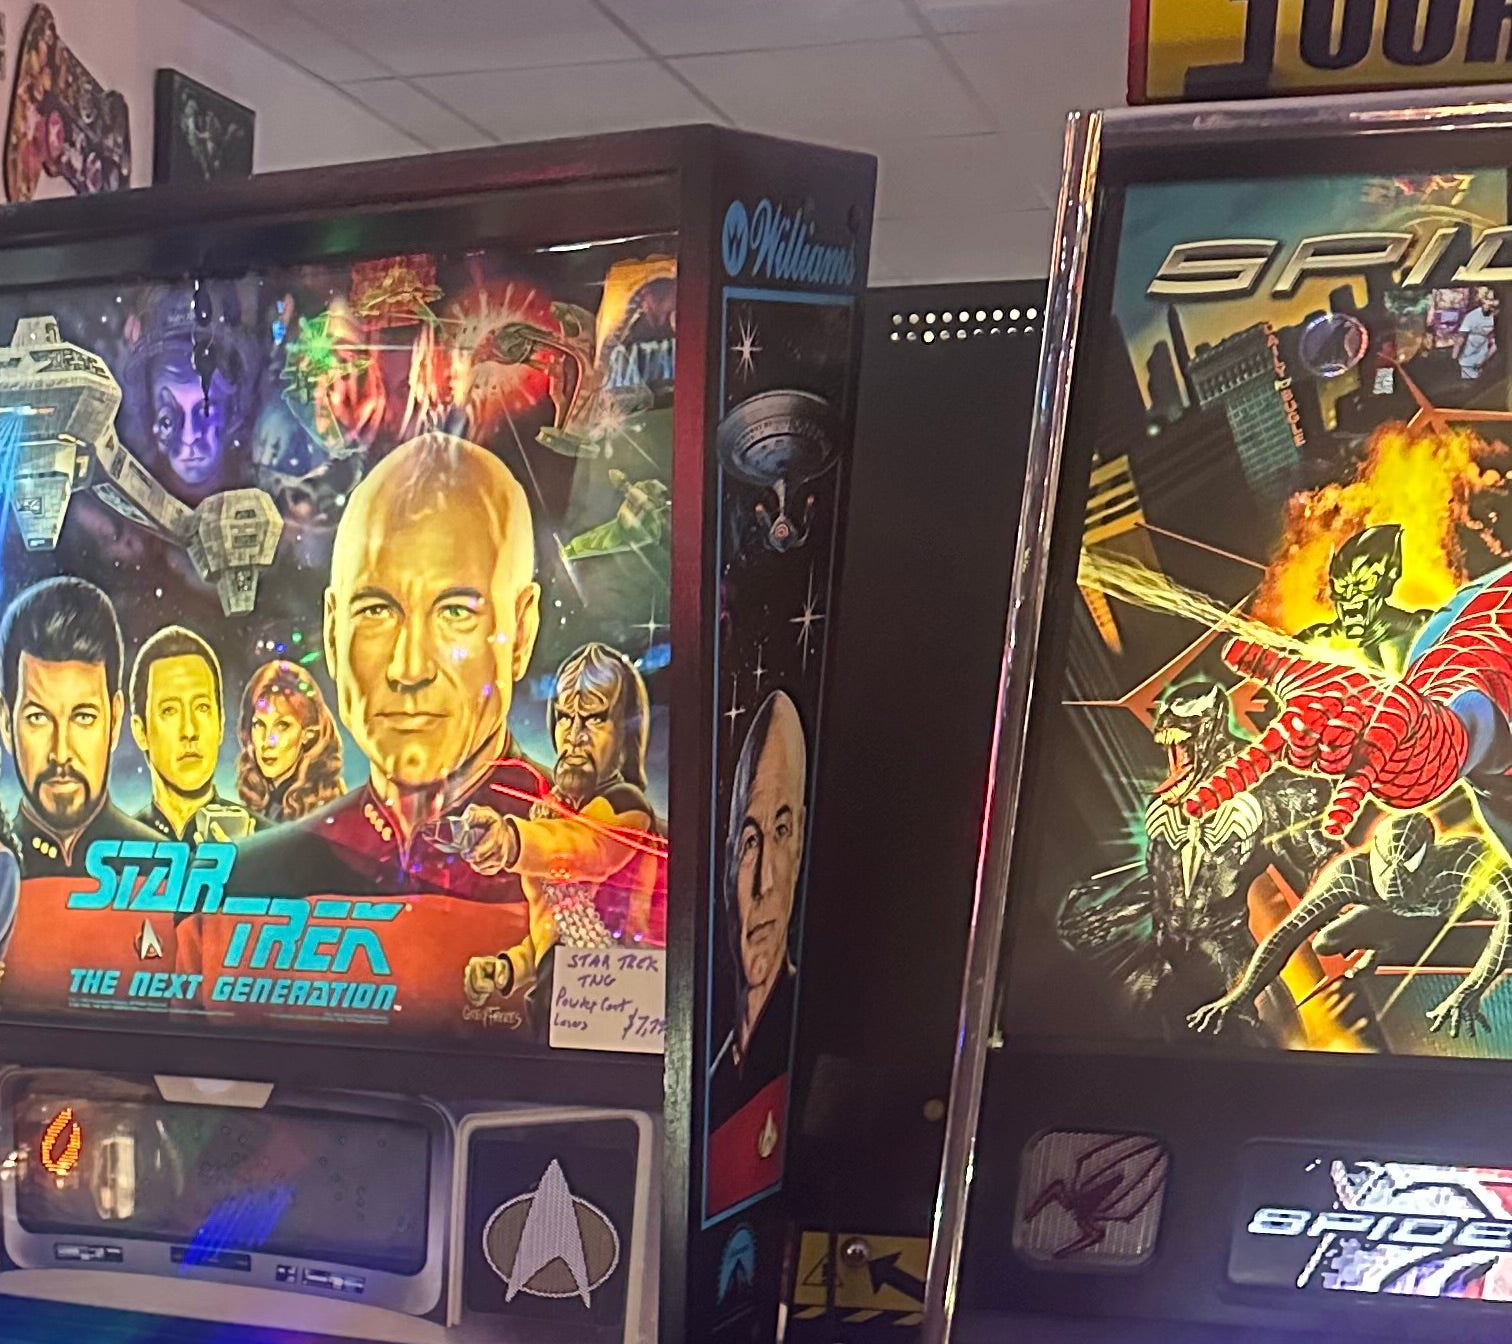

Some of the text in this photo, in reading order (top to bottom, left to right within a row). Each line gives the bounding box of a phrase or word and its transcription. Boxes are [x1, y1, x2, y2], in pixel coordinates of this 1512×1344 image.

[750, 199, 856, 285] Williams
[1263, 322, 1286, 378] DAILY
[1279, 388, 1306, 447] BUGLE
[67, 840, 238, 914] STAR
[222, 896, 404, 975] TREK
[567, 953, 658, 973] STAR TREK
[70, 968, 121, 994] THE
[128, 970, 204, 999] NEXT
[211, 975, 397, 1011] GENERATION
[577, 973, 616, 988] TNG
